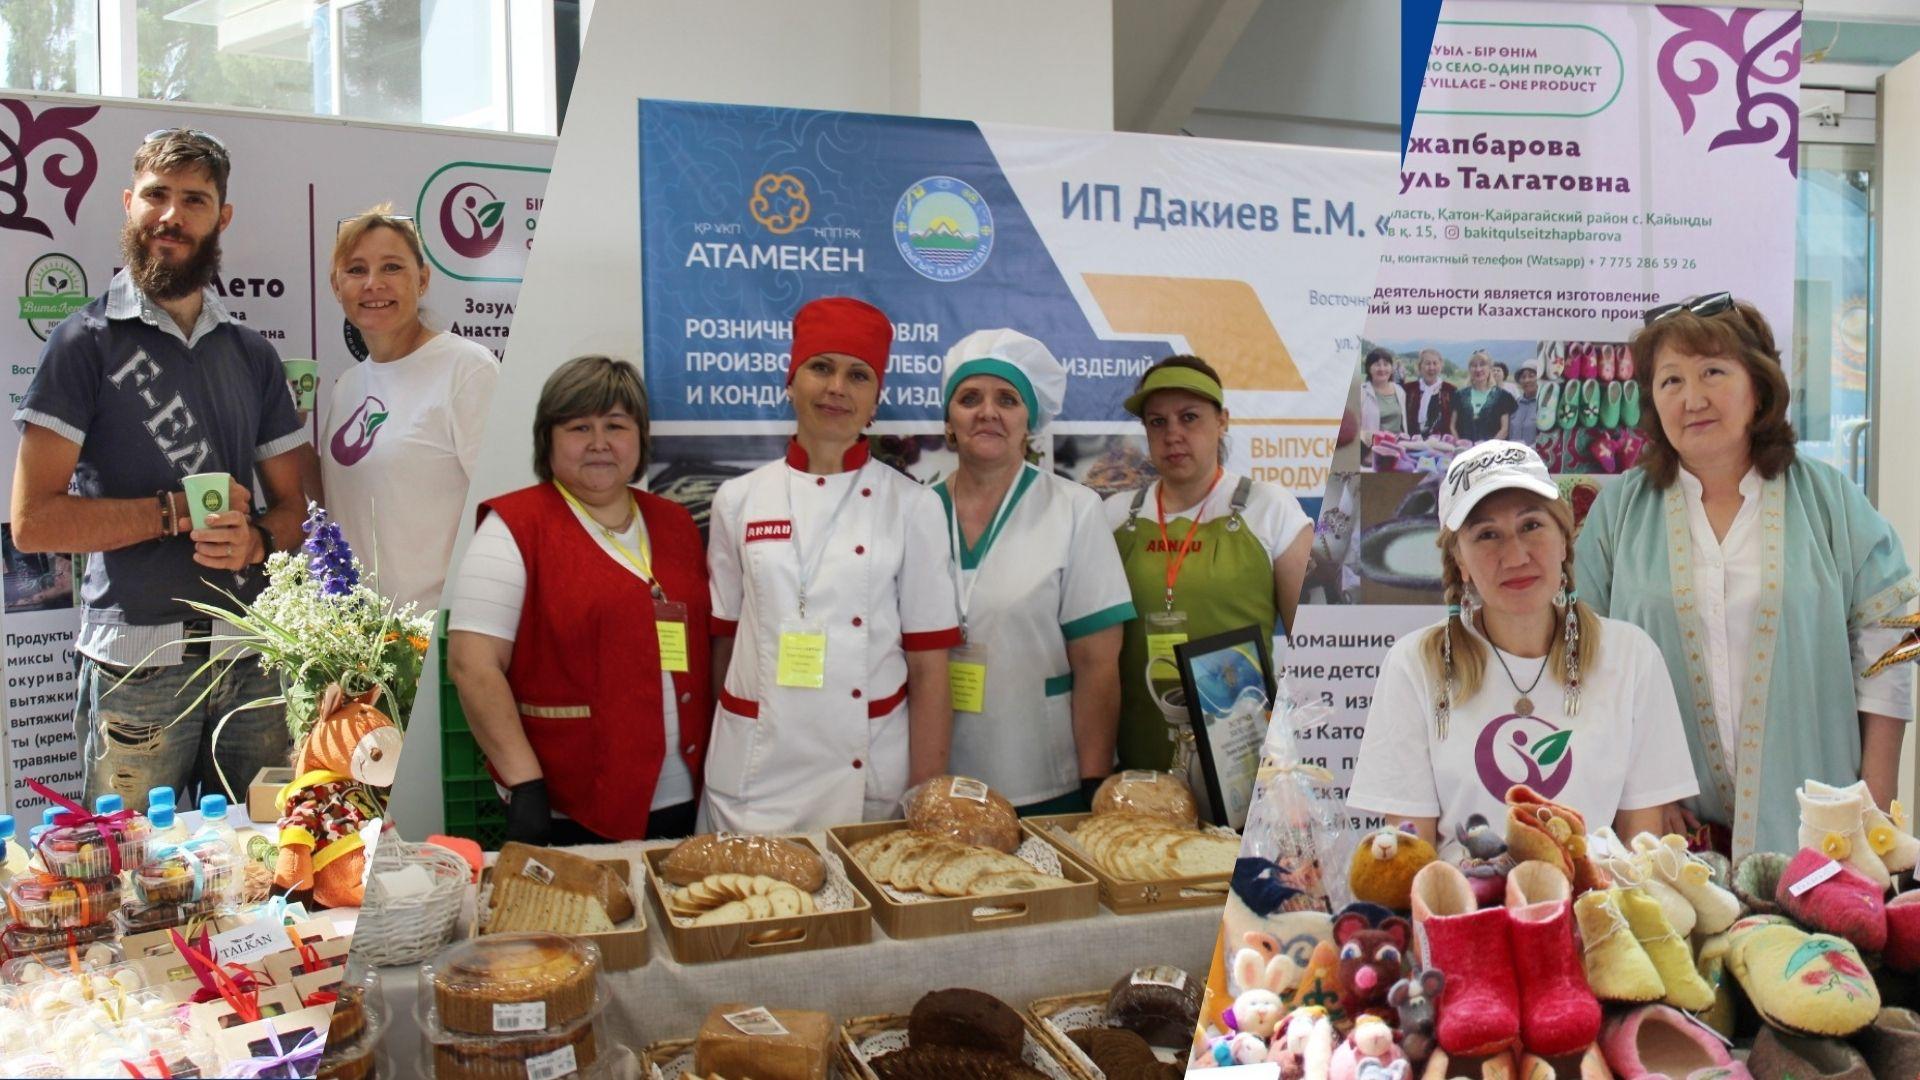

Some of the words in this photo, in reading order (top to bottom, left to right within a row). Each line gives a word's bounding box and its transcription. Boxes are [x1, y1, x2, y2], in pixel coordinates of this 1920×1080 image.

[1430, 46, 1463, 57] УЫЛ
[1475, 47, 1496, 57] БІР
[1500, 47, 1538, 59] ӨНІМ
[1446, 62, 1530, 76] СЕЛО-ОДИН
[1535, 64, 1602, 78] ПРОДУКТ
[1432, 77, 1486, 89] VILLAGE
[1499, 80, 1528, 90] ONE
[1531, 80, 1598, 92] PRODUCT
[1409, 133, 1581, 162] жапбарова
[1399, 171, 1451, 195] уль
[1457, 166, 1631, 193] Талгатовна
[1061, 181, 1121, 222] ИП
[1133, 187, 1280, 231] Дакиев
[1292, 197, 1366, 238] Е.М.
[1391, 209, 1435, 222] ласть,
[1587, 213, 1628, 226] район
[845, 229, 861, 240] РК
[1416, 226, 1437, 239] 15,
[685, 242, 864, 272] АТАМЕКЕН
[1398, 254, 1469, 265] контактный
[1473, 255, 1523, 267] телефон
[1526, 255, 1585, 269] (Watsapp)
[1600, 257, 1608, 267] 7
[1610, 257, 1632, 268] 775
[1637, 258, 1659, 269] 286
[1663, 258, 1678, 269] 59
[1682, 259, 1697, 269] 26
[1374, 287, 1479, 300] деятельности
[1484, 289, 1552, 300] является
[1557, 290, 1660, 303] изготовление
[465, 298, 516, 319] Зозул
[1395, 305, 1412, 315] из
[1417, 305, 1473, 318] шерсти
[1478, 303, 1597, 318] Казахстанского
[1335, 337, 1354, 352] ул.
[884, 355, 946, 375] ЛЕБО
[1062, 355, 1154, 379] ИЗДЕЛИЙ
[686, 385, 702, 405] И
[1251, 466, 1329, 490] ПРОДУ
[746, 522, 791, 537] ARNAU
[6, 629, 74, 648] Продукты
[8, 653, 54, 667] миксы
[12, 738, 29, 748] ты
[35, 732, 76, 748] (крем
[13, 751, 77, 770] травяные
[16, 797, 47, 809] соли
[220, 933, 273, 958] TALKAN
